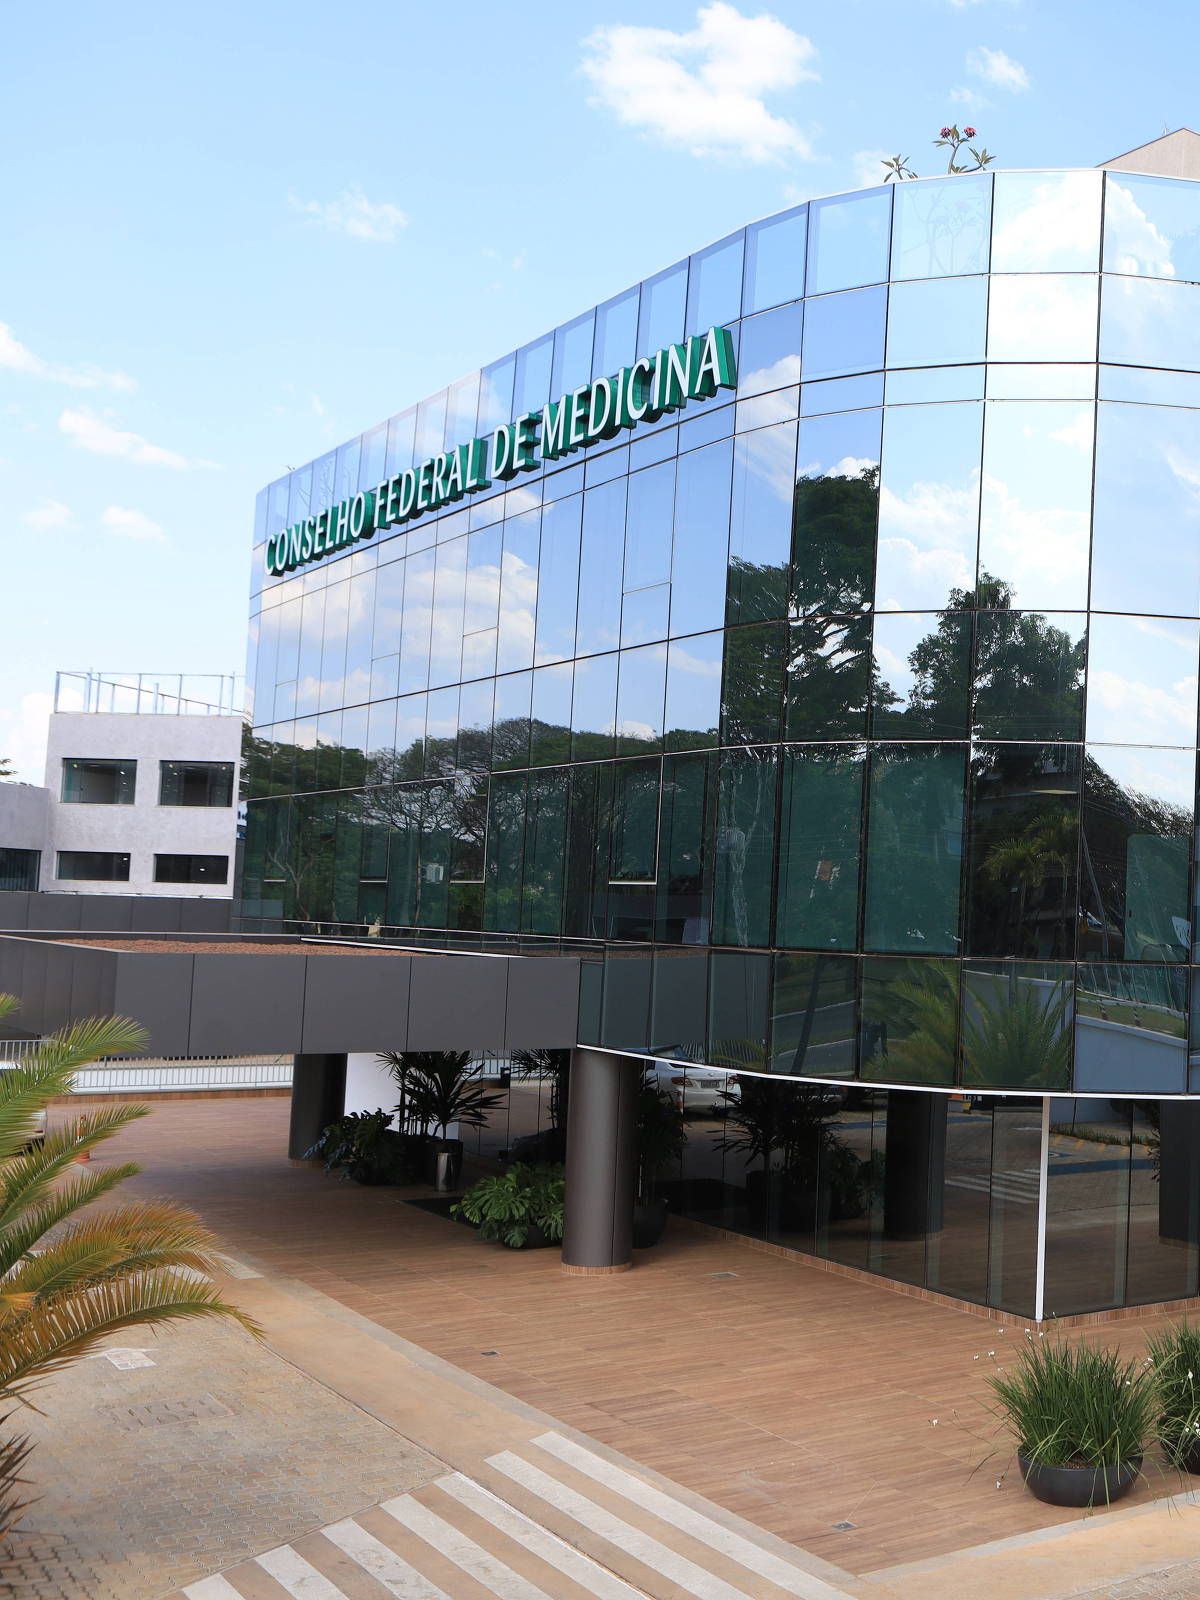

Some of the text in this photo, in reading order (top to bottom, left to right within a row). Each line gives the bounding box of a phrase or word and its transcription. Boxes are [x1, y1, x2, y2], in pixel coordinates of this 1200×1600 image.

[264, 327, 729, 576] CONSELHO FEDERAL DE MEDICINA
